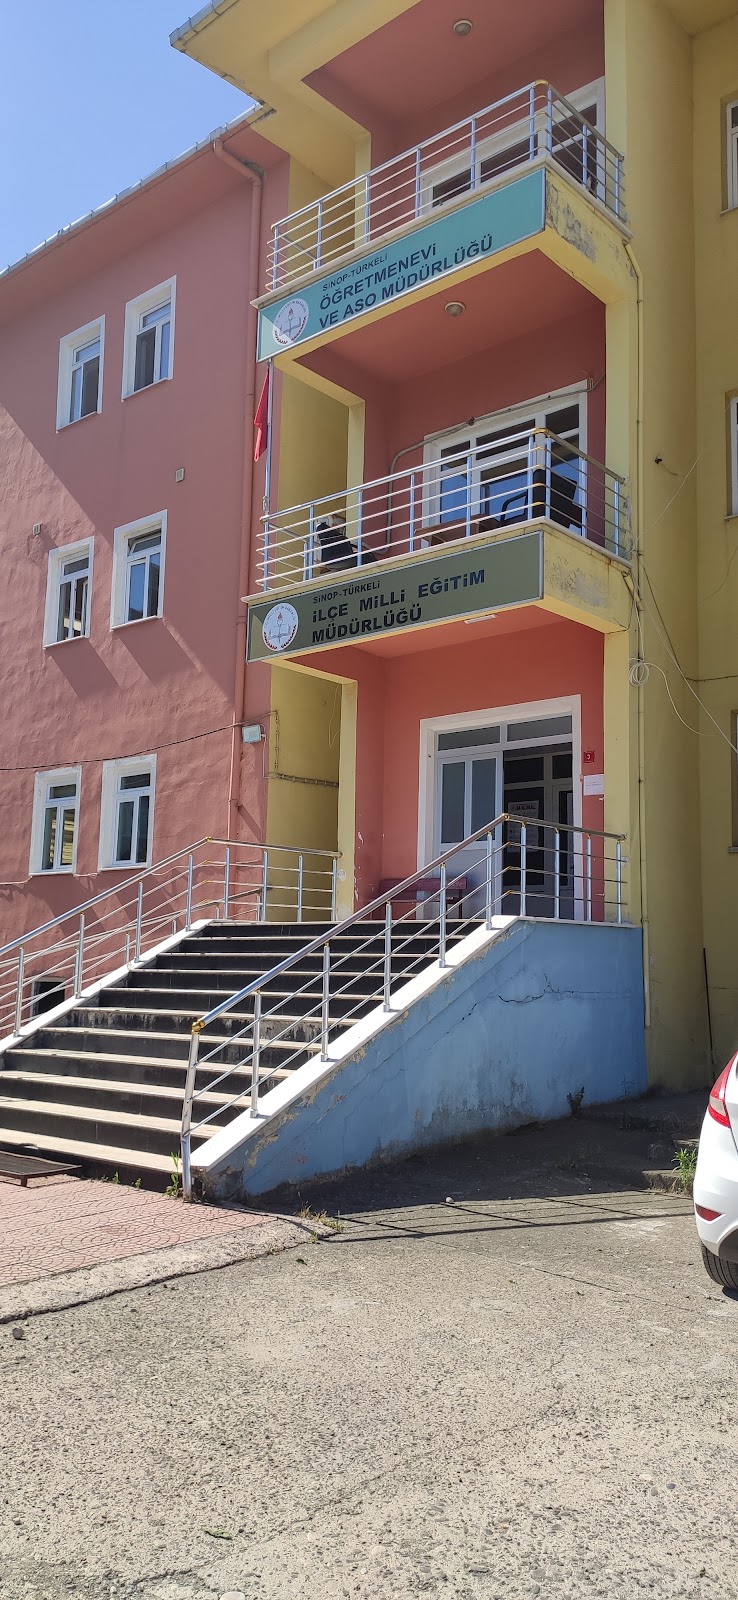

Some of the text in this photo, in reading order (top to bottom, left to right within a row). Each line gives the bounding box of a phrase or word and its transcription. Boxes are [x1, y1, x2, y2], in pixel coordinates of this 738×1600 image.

[318, 312, 339, 329] VE
[343, 293, 377, 318] ASO
[381, 234, 493, 304] MÜDÜRLÜĞÜ
[312, 605, 422, 643] MÜDÜRLÜĞÜ
